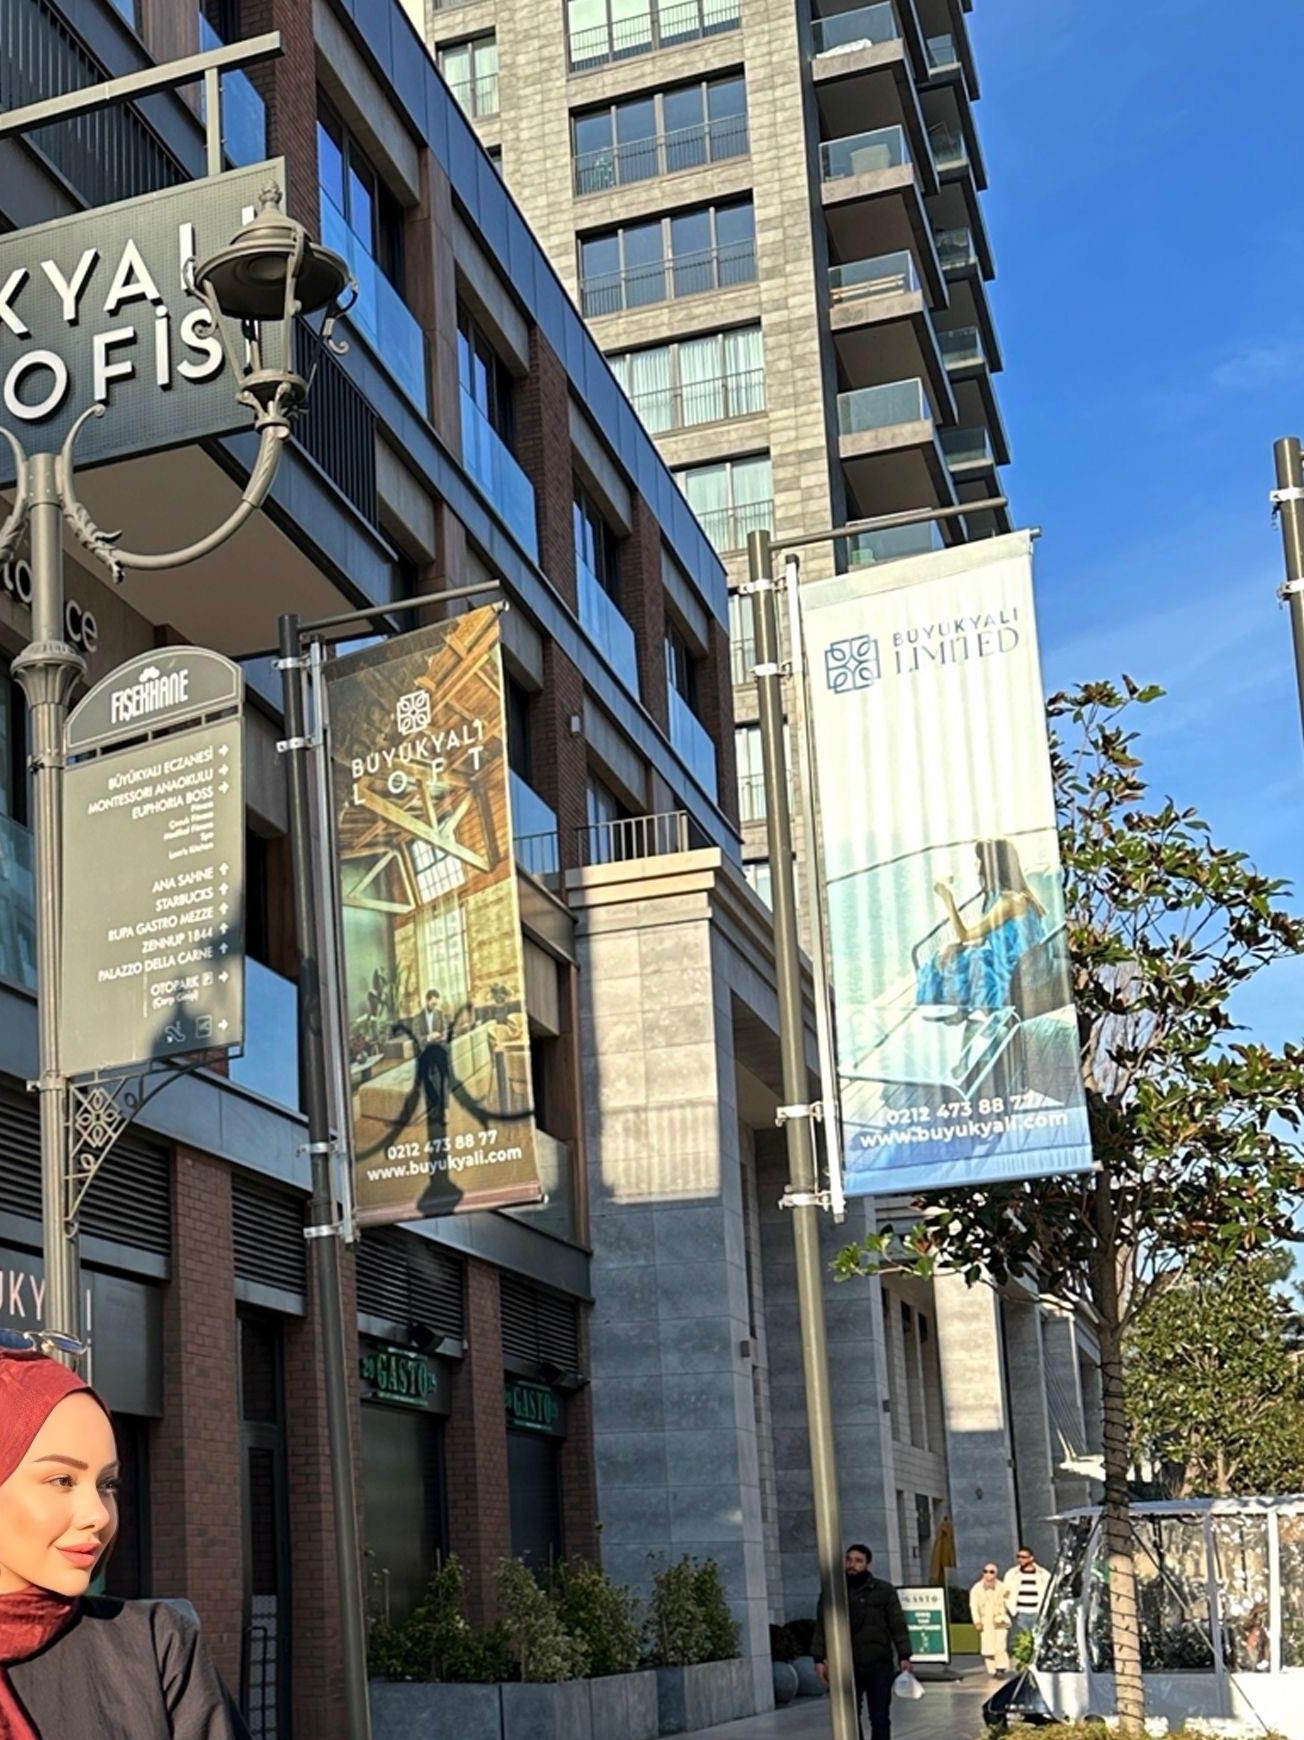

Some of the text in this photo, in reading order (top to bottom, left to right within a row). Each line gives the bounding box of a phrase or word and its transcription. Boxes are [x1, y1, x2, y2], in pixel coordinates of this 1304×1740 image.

[155, 768, 214, 796] ANAOKULU
[152, 866, 214, 894] ANA SAHNE
[155, 886, 214, 912] STARBUCKS
[136, 915, 178, 936] GASTRO
[180, 906, 214, 925] MEZZE
[98, 946, 214, 983] PALAZZO DELLA CARNE
[150, 974, 200, 996] OTOPARK
[886, 1091, 1036, 1126] 0212 473 88 77
[387, 1129, 498, 1160] 0212 473 88 77
[860, 1111, 1069, 1148] www.buyukyali.com
[367, 1146, 522, 1182] www.buyukyali.com
[377, 1353, 428, 1398] GASTO
[513, 1386, 552, 1424] GASTO
